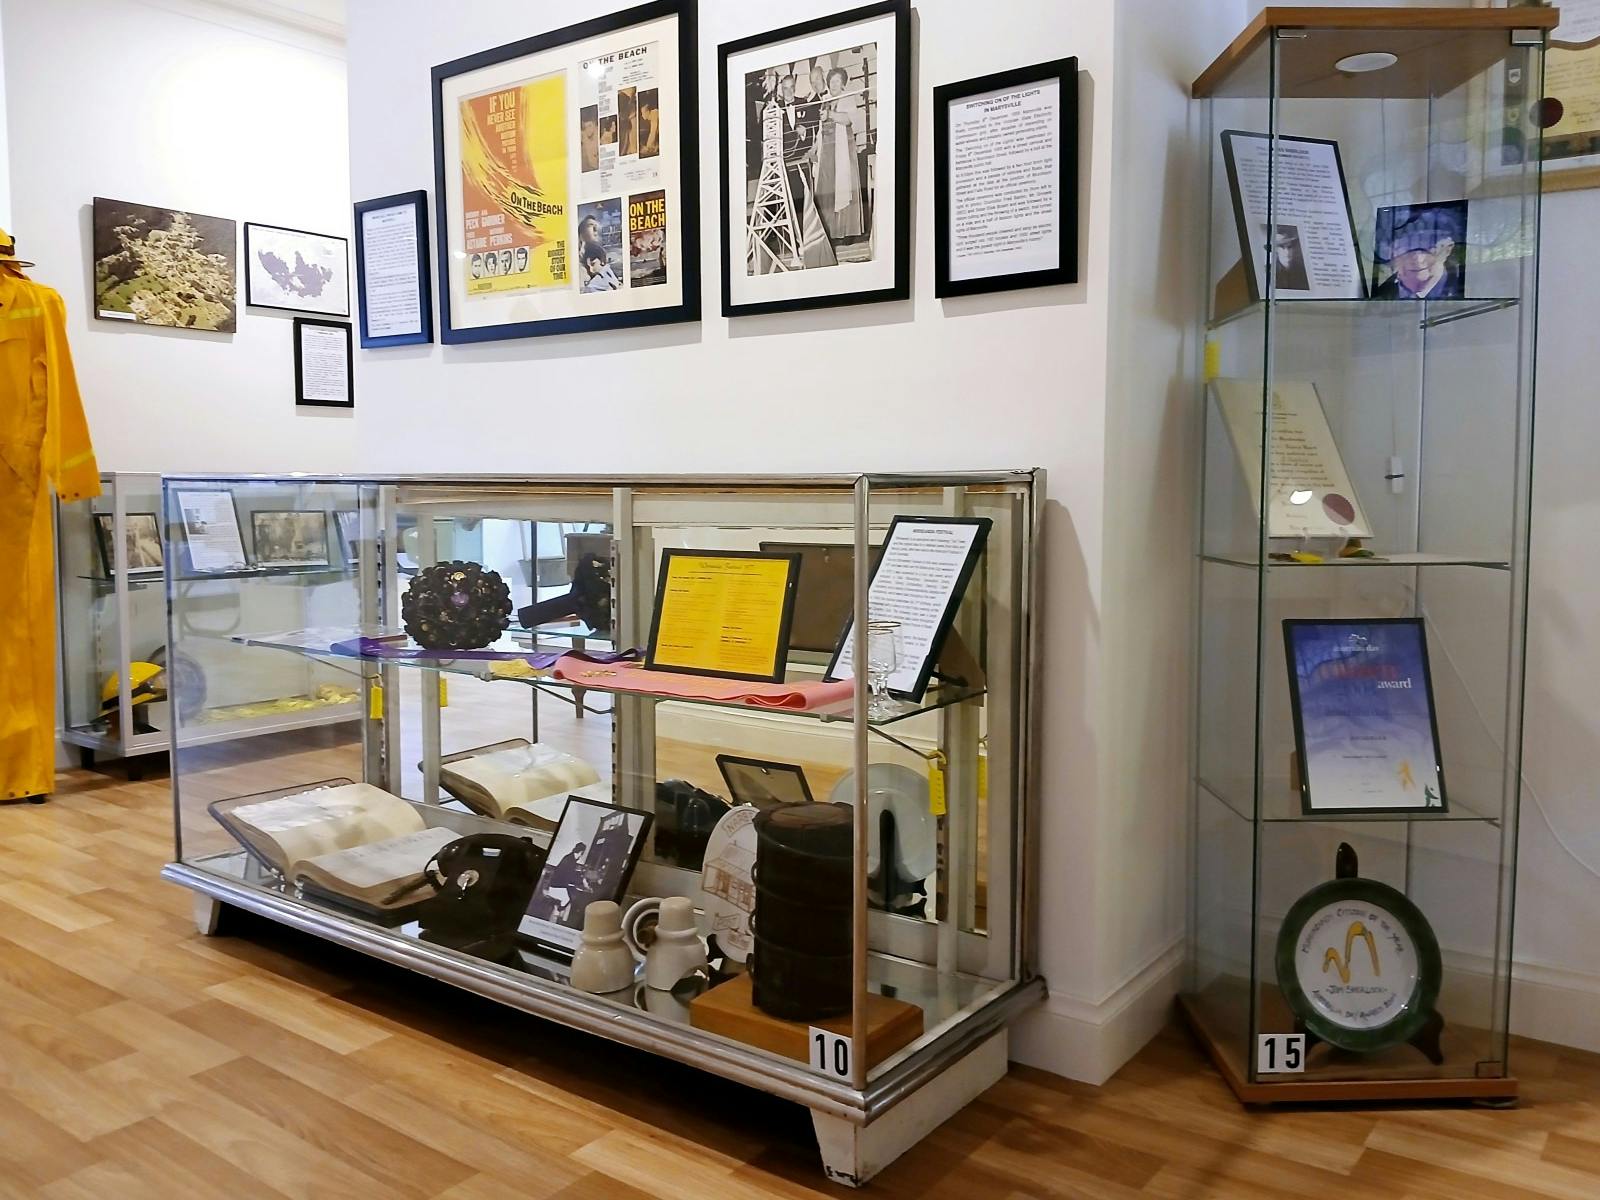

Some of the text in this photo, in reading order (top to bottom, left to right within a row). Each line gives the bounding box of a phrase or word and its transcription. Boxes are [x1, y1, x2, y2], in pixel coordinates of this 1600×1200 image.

[599, 54, 615, 66] THE
[618, 47, 648, 61] BEACH
[489, 91, 517, 114] IF YOU
[966, 89, 1041, 110] SWITCHING ON OF THE LIGHTS
[991, 101, 1022, 112] MARYSVILLE
[487, 109, 517, 126] NEVER SEE
[511, 191, 564, 216] ON THE BEACH
[630, 202, 645, 218] ON
[645, 198, 665, 213] THE
[630, 213, 666, 232] BEACH
[1377, 677, 1413, 689] award
[815, 1033, 849, 1077] 10
[1264, 1037, 1301, 1069] 15
